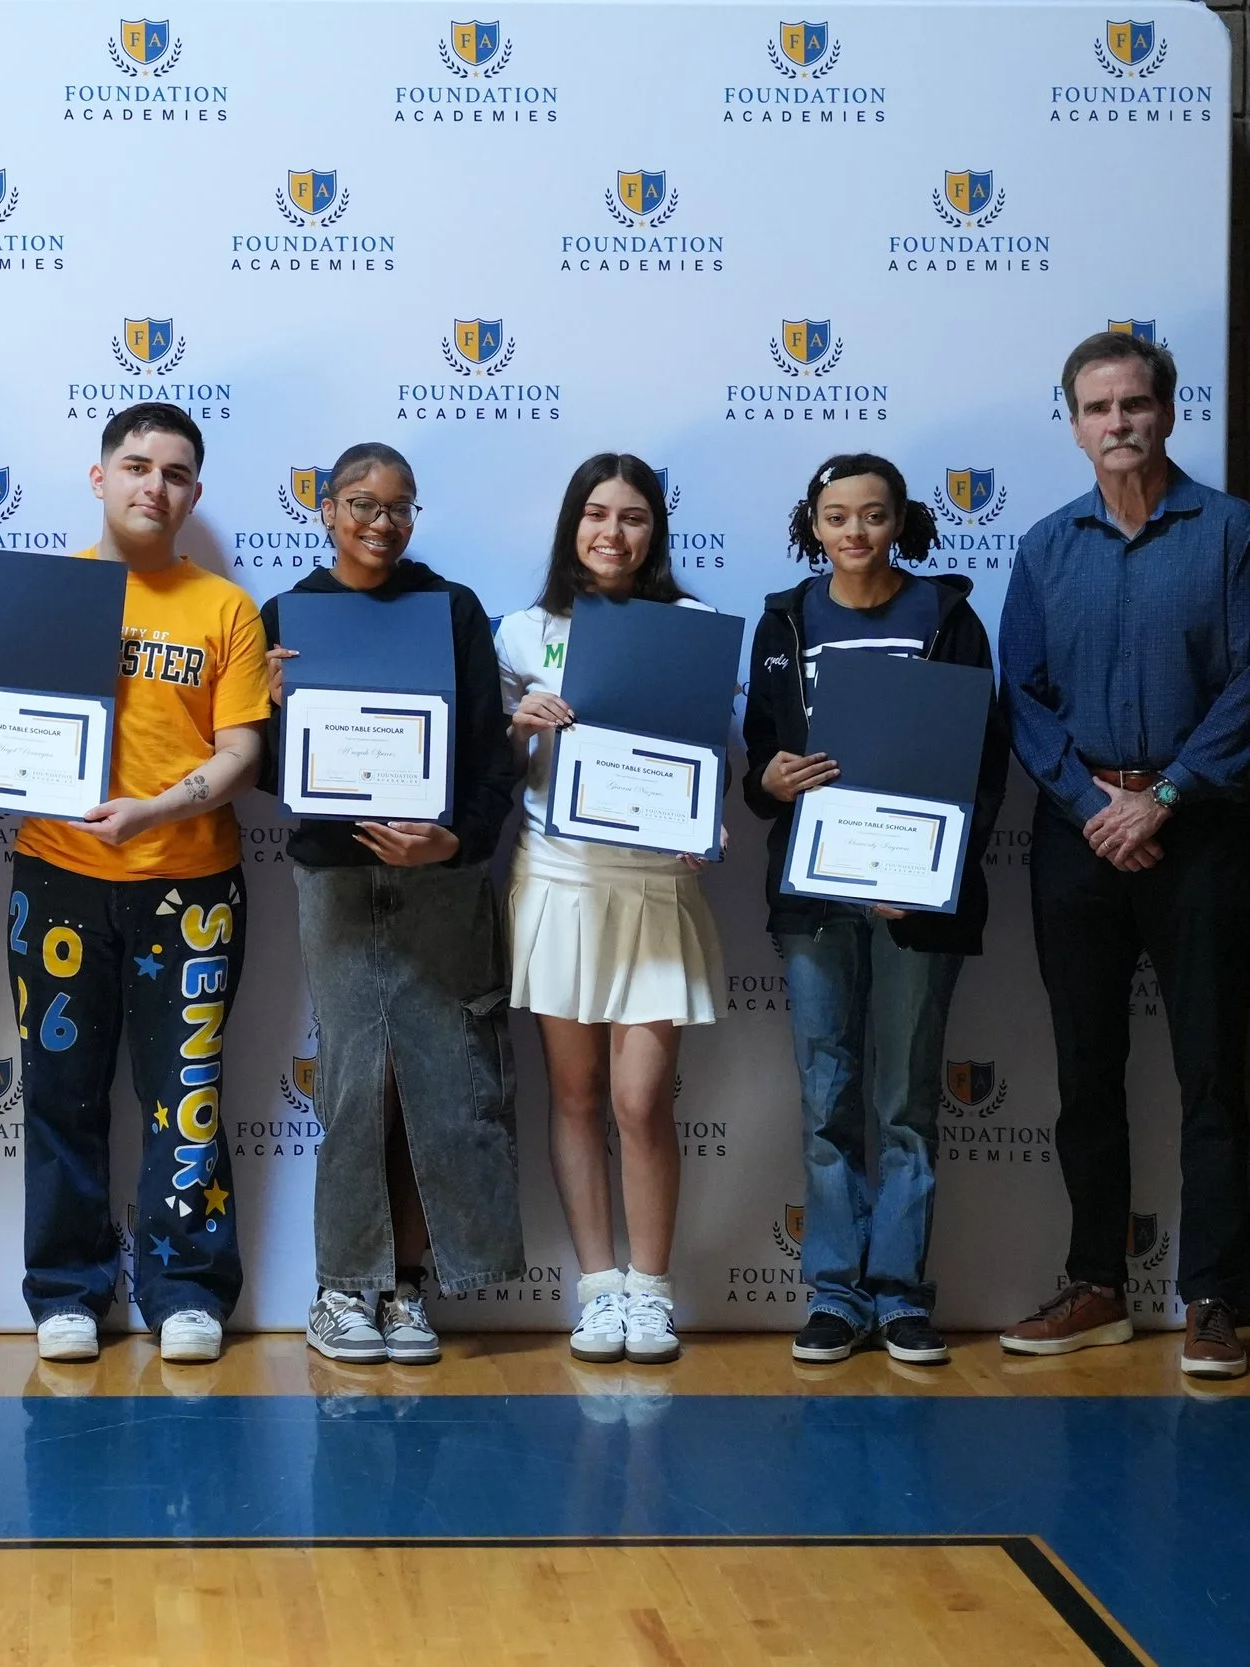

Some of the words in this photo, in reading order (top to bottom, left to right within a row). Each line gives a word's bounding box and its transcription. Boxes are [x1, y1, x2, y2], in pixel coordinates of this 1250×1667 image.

[64, 85, 228, 103] FOUNDATION
[396, 87, 558, 104] FOUNDATION
[724, 87, 886, 104] FOUNDATION
[1051, 86, 1213, 103] FOUNDATION
[63, 108, 227, 122] ACADEMIES
[394, 110, 557, 122] ACADEMIES
[723, 110, 885, 123] ACADEMIES
[1050, 109, 1211, 122] ACADEMIES
[232, 235, 395, 253] FOUNDATION
[561, 236, 724, 253] FOUNDATION
[889, 236, 1050, 253] FOUNDATION
[231, 258, 394, 271] ACADEMIES
[560, 259, 723, 272] ACADEMIES
[888, 259, 1049, 272] ACADEMIES
[68, 384, 231, 401] FOUNDATION
[398, 384, 561, 401] FOUNDATION
[726, 385, 888, 402] FOUNDATION
[397, 407, 560, 420] ACADEMIES
[725, 408, 887, 421] ACADEMIES
[234, 532, 336, 550] FOUNDA
[152, 630, 170, 640] OF
[119, 638, 206, 688] STER
[8, 724, 28, 733] TABLE
[29, 727, 61, 736] SCHOLAR
[324, 724, 350, 732] ROUND
[351, 725, 371, 733] TABLE
[372, 726, 404, 734] SCHOLAR
[595, 759, 621, 769] ROUND
[621, 764, 641, 773] TABLE
[642, 768, 674, 778] SCHOLAR
[837, 818, 863, 827] ROUND
[864, 821, 884, 829] TABLE
[885, 823, 917, 833] SCHOLAR
[172, 902, 233, 1191] SENIOR
[236, 1121, 324, 1138] FOUND
[942, 1126, 1052, 1145] NDATION
